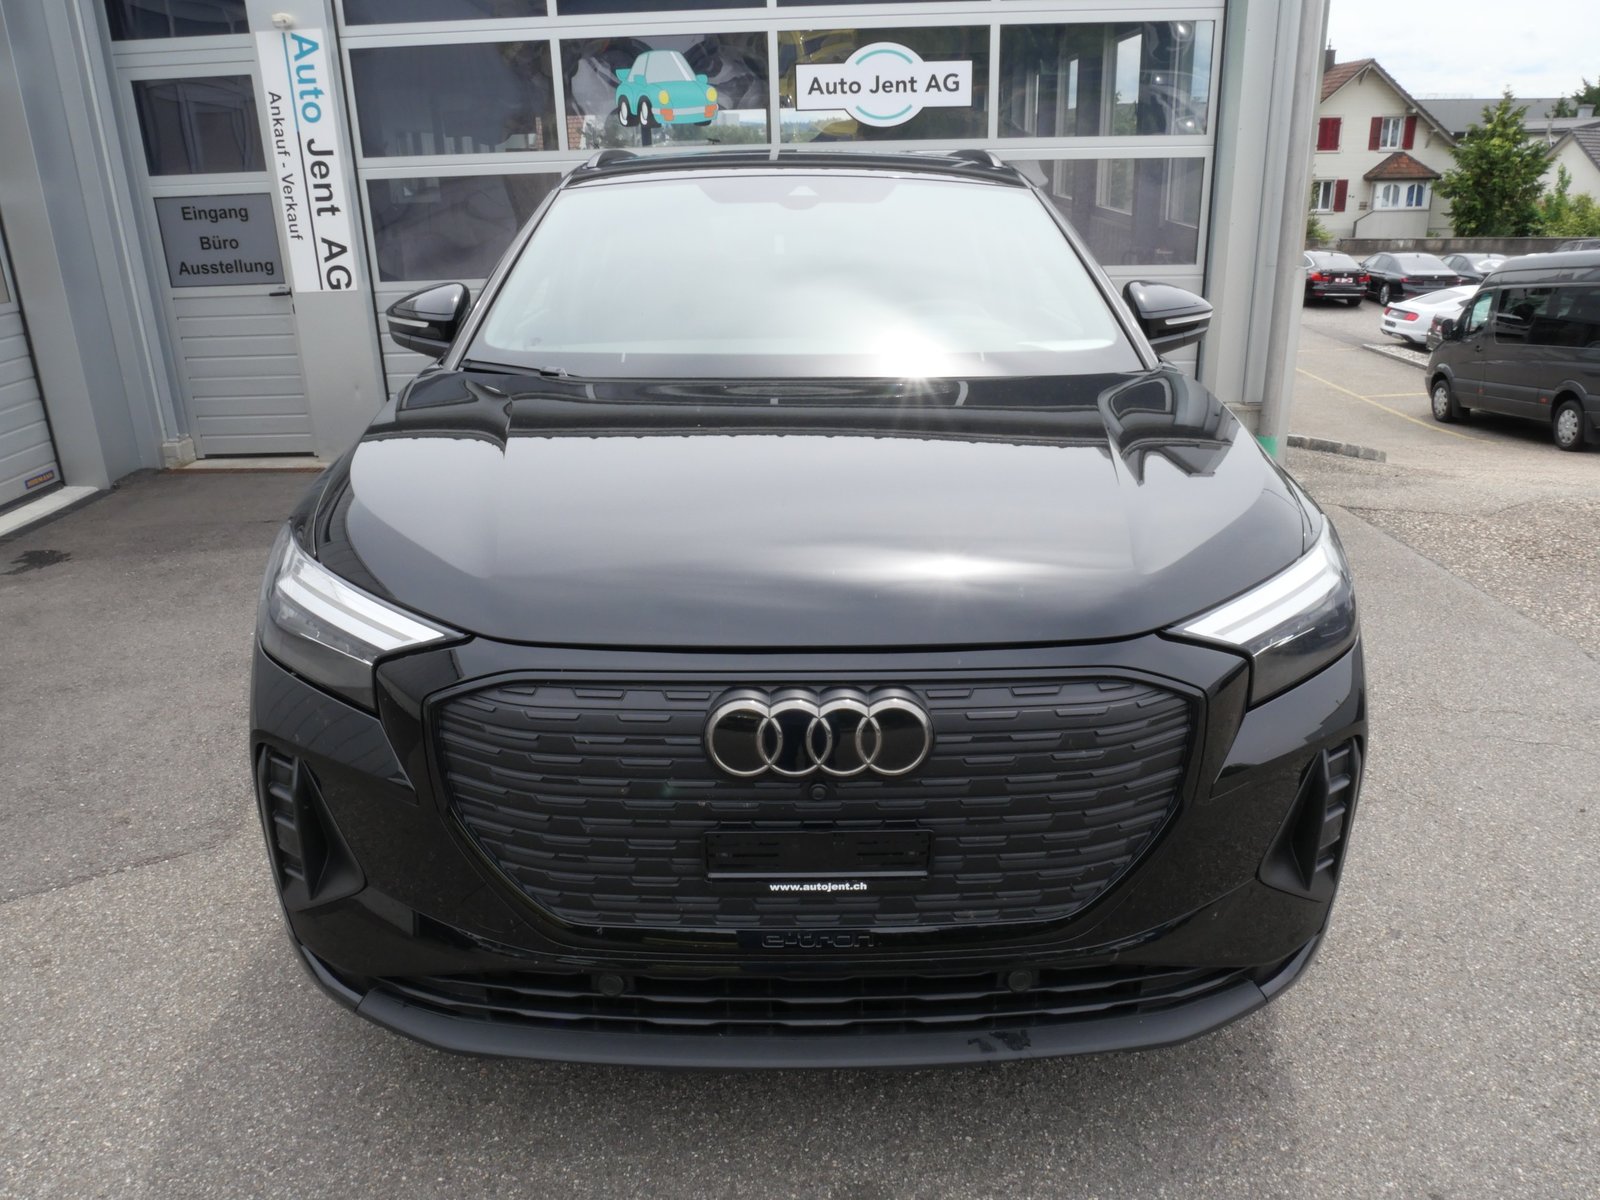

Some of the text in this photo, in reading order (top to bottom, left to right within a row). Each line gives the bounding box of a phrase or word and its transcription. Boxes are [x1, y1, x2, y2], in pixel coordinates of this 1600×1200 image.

[807, 73, 960, 95] Auto Jent AG
[268, 91, 291, 157] Ankauf
[281, 173, 304, 241] Verkauf
[290, 32, 352, 290] Auto Jent AG
[181, 206, 249, 223] Eingang
[199, 235, 239, 250] Büro
[178, 259, 275, 276] Ausstellung
[769, 882, 868, 893] www.autojent.ch
